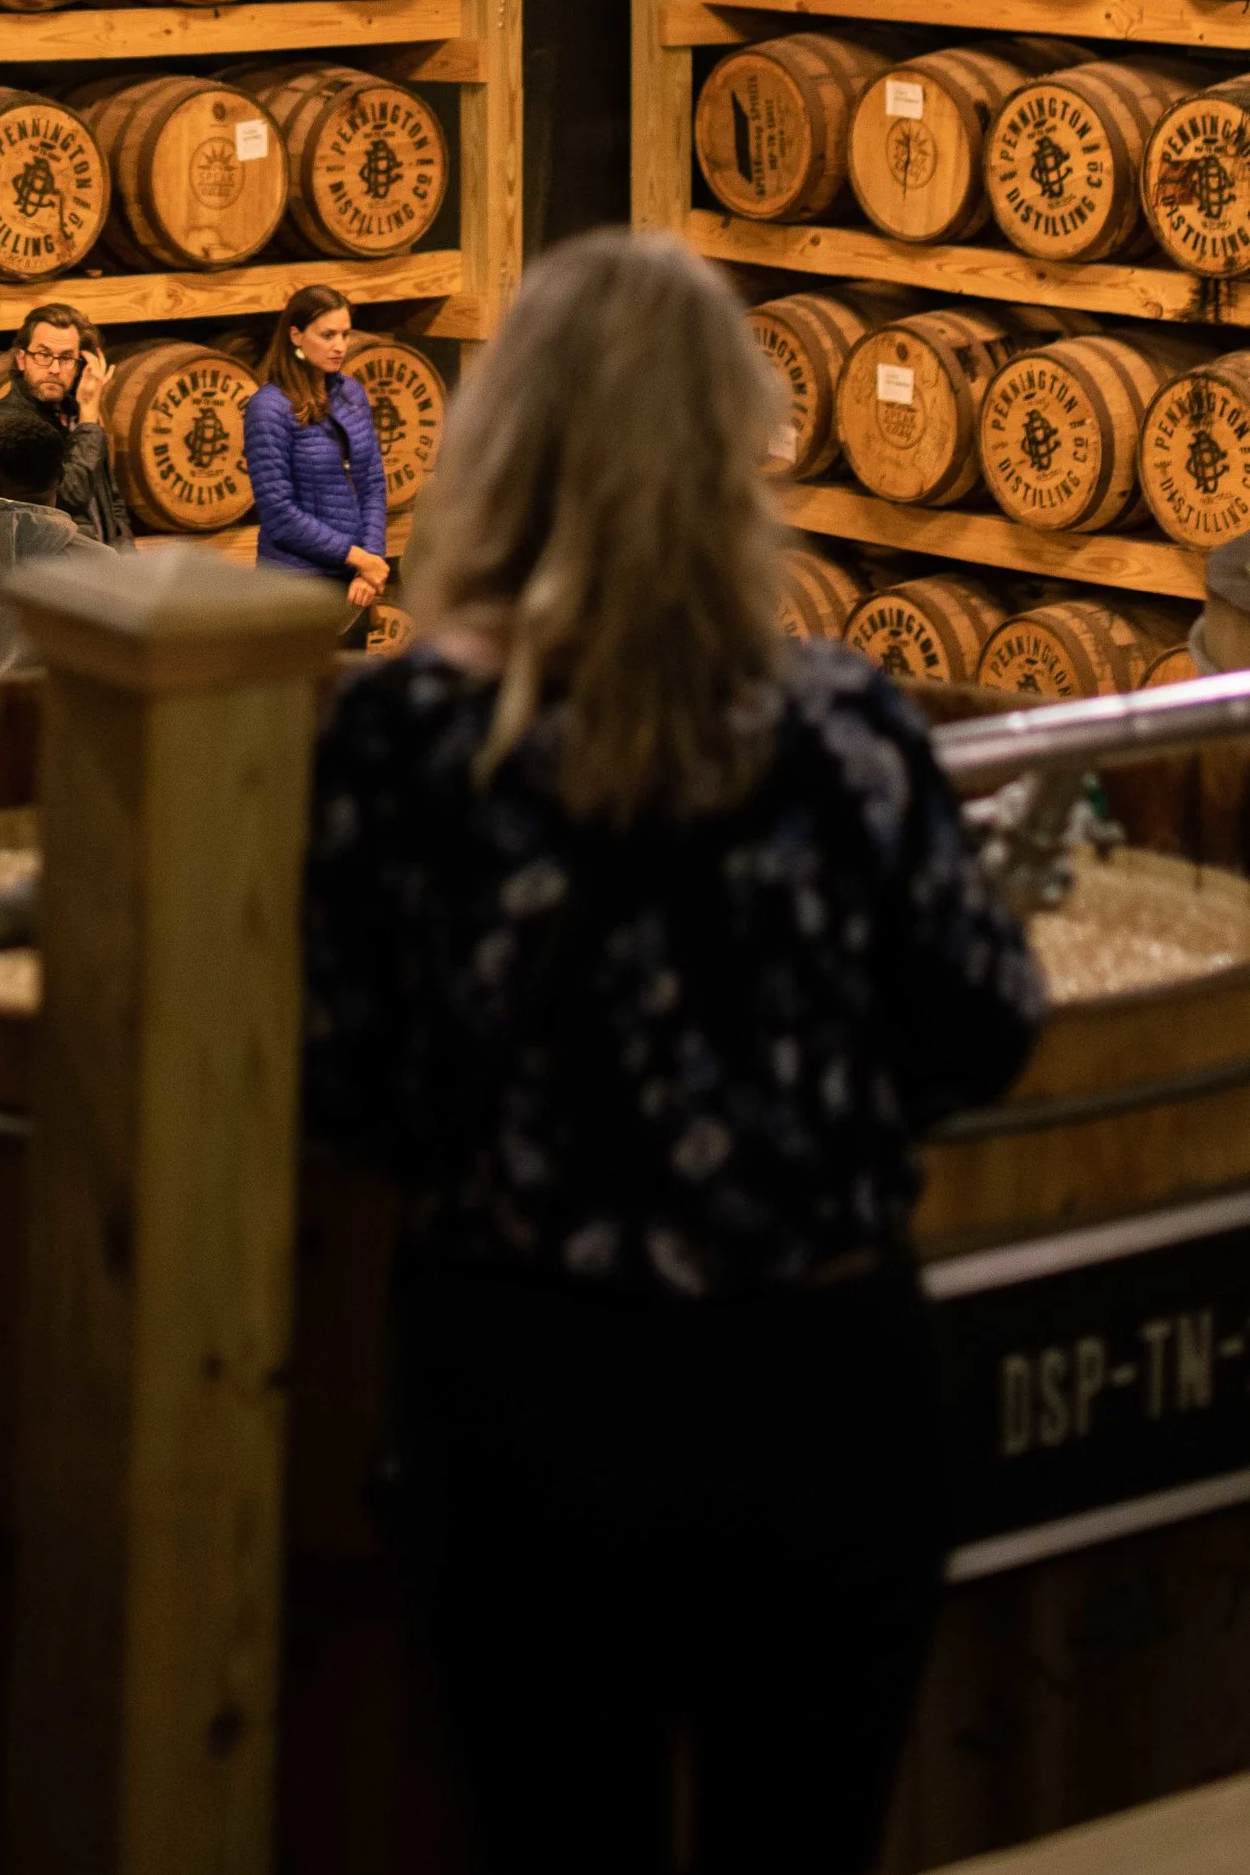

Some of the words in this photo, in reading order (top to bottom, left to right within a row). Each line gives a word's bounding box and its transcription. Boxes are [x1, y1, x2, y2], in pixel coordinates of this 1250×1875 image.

[330, 101, 430, 156] PENNINGTON
[999, 96, 1093, 163] PENNINGTON
[328, 180, 416, 237] DISTILLING
[1006, 186, 1097, 237] DISTILLING
[991, 369, 1079, 432] PENNINGTON
[153, 442, 238, 506] DISTILLING
[997, 456, 1081, 509] DISTILLING
[1159, 476, 1249, 533] DISTILLING
[999, 1306, 1250, 1458] DSP-TN-
